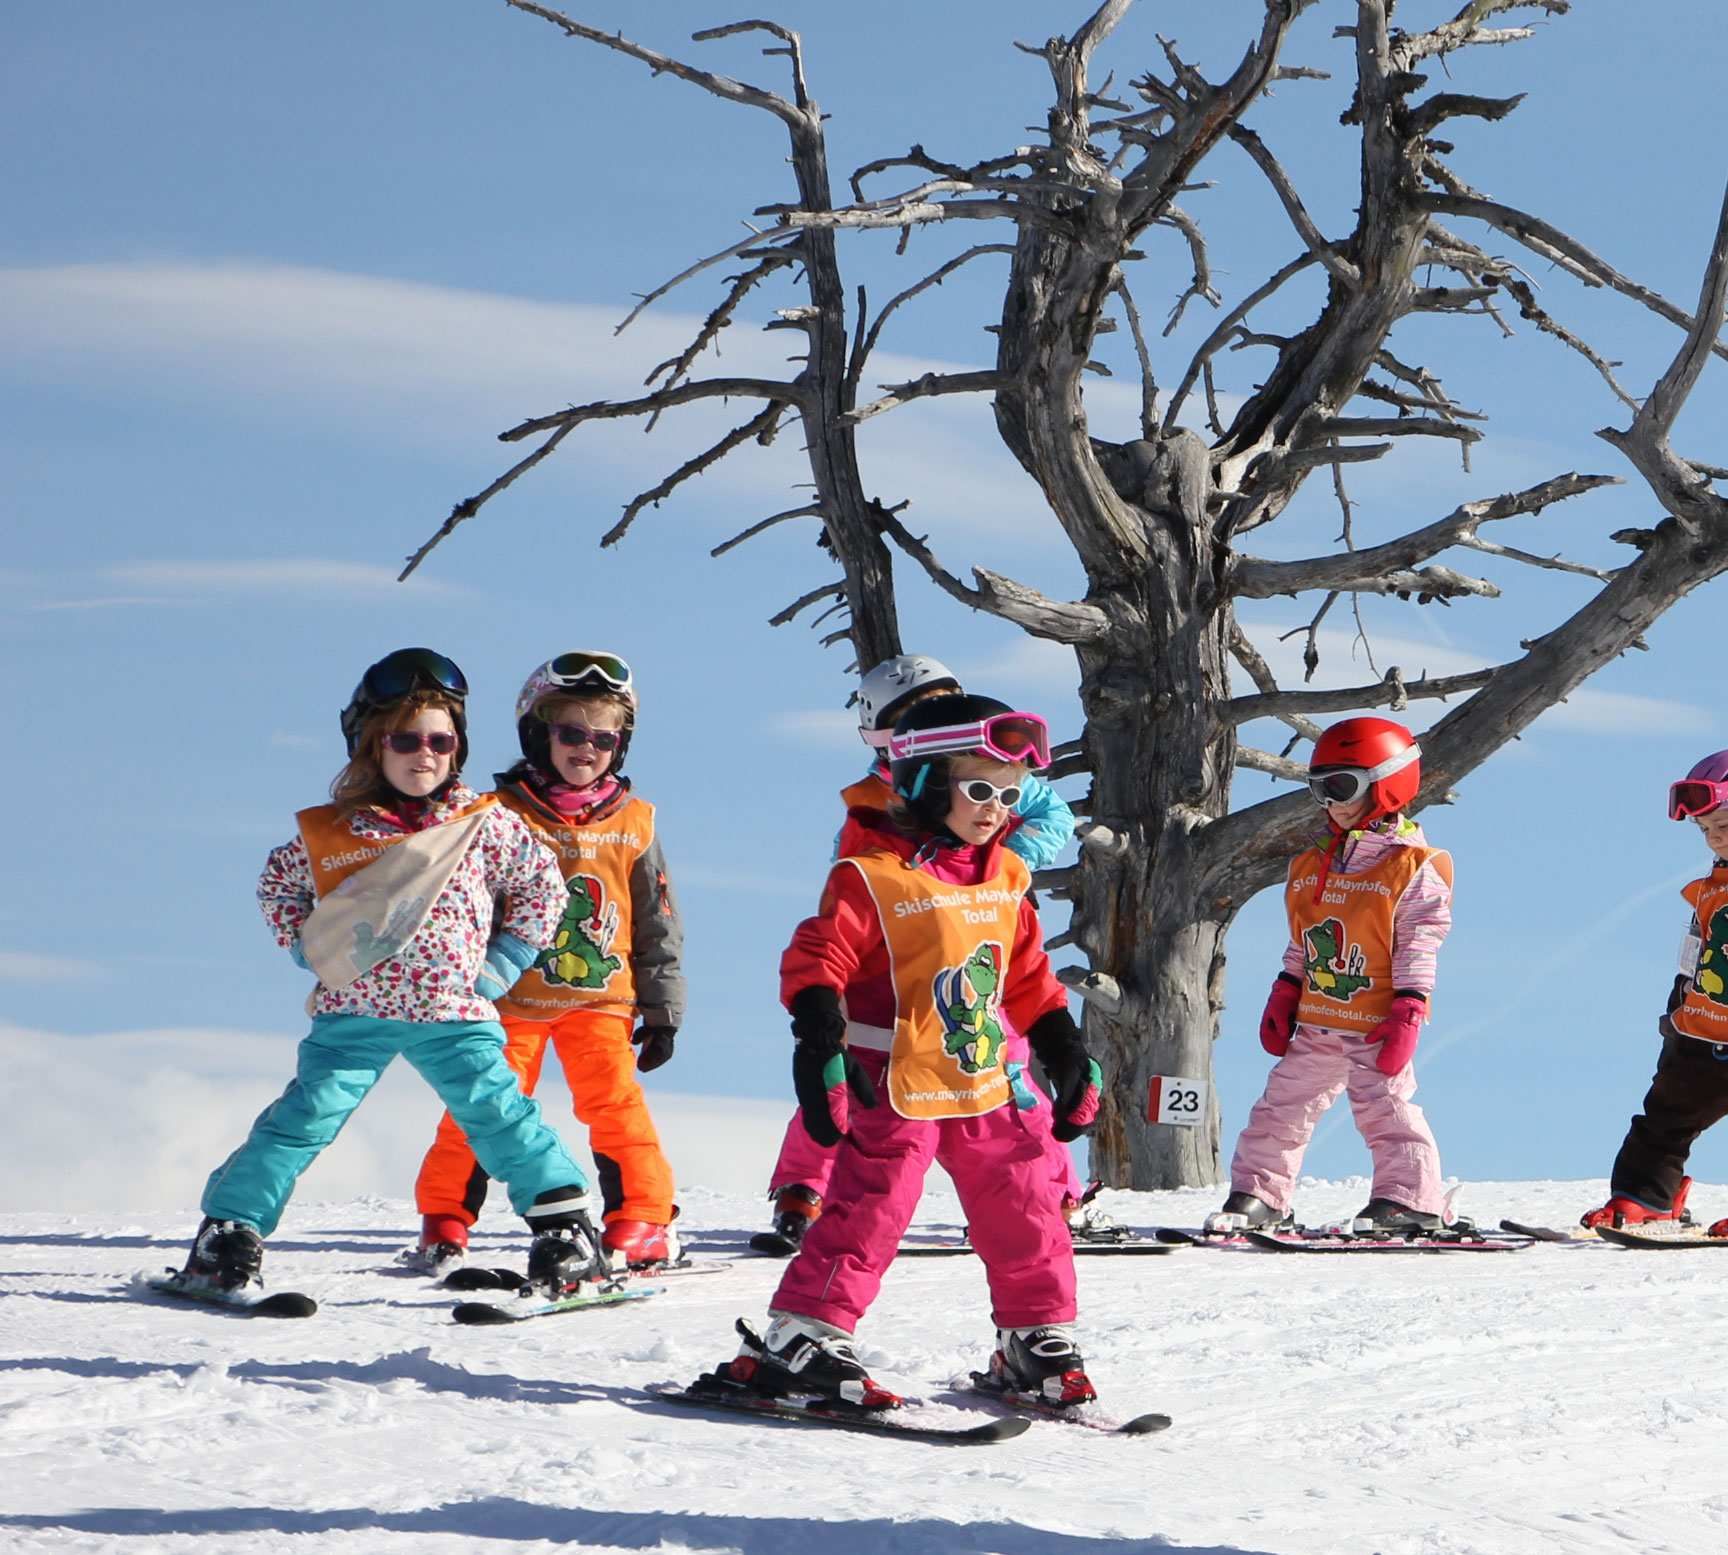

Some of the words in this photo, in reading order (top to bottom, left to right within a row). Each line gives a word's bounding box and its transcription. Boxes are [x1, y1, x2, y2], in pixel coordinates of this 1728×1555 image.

[319, 839, 390, 873] Skischul
[559, 845, 597, 860] Total
[893, 890, 972, 919] Skischule
[962, 906, 999, 925] Total
[1167, 1089, 1199, 1113] 23
